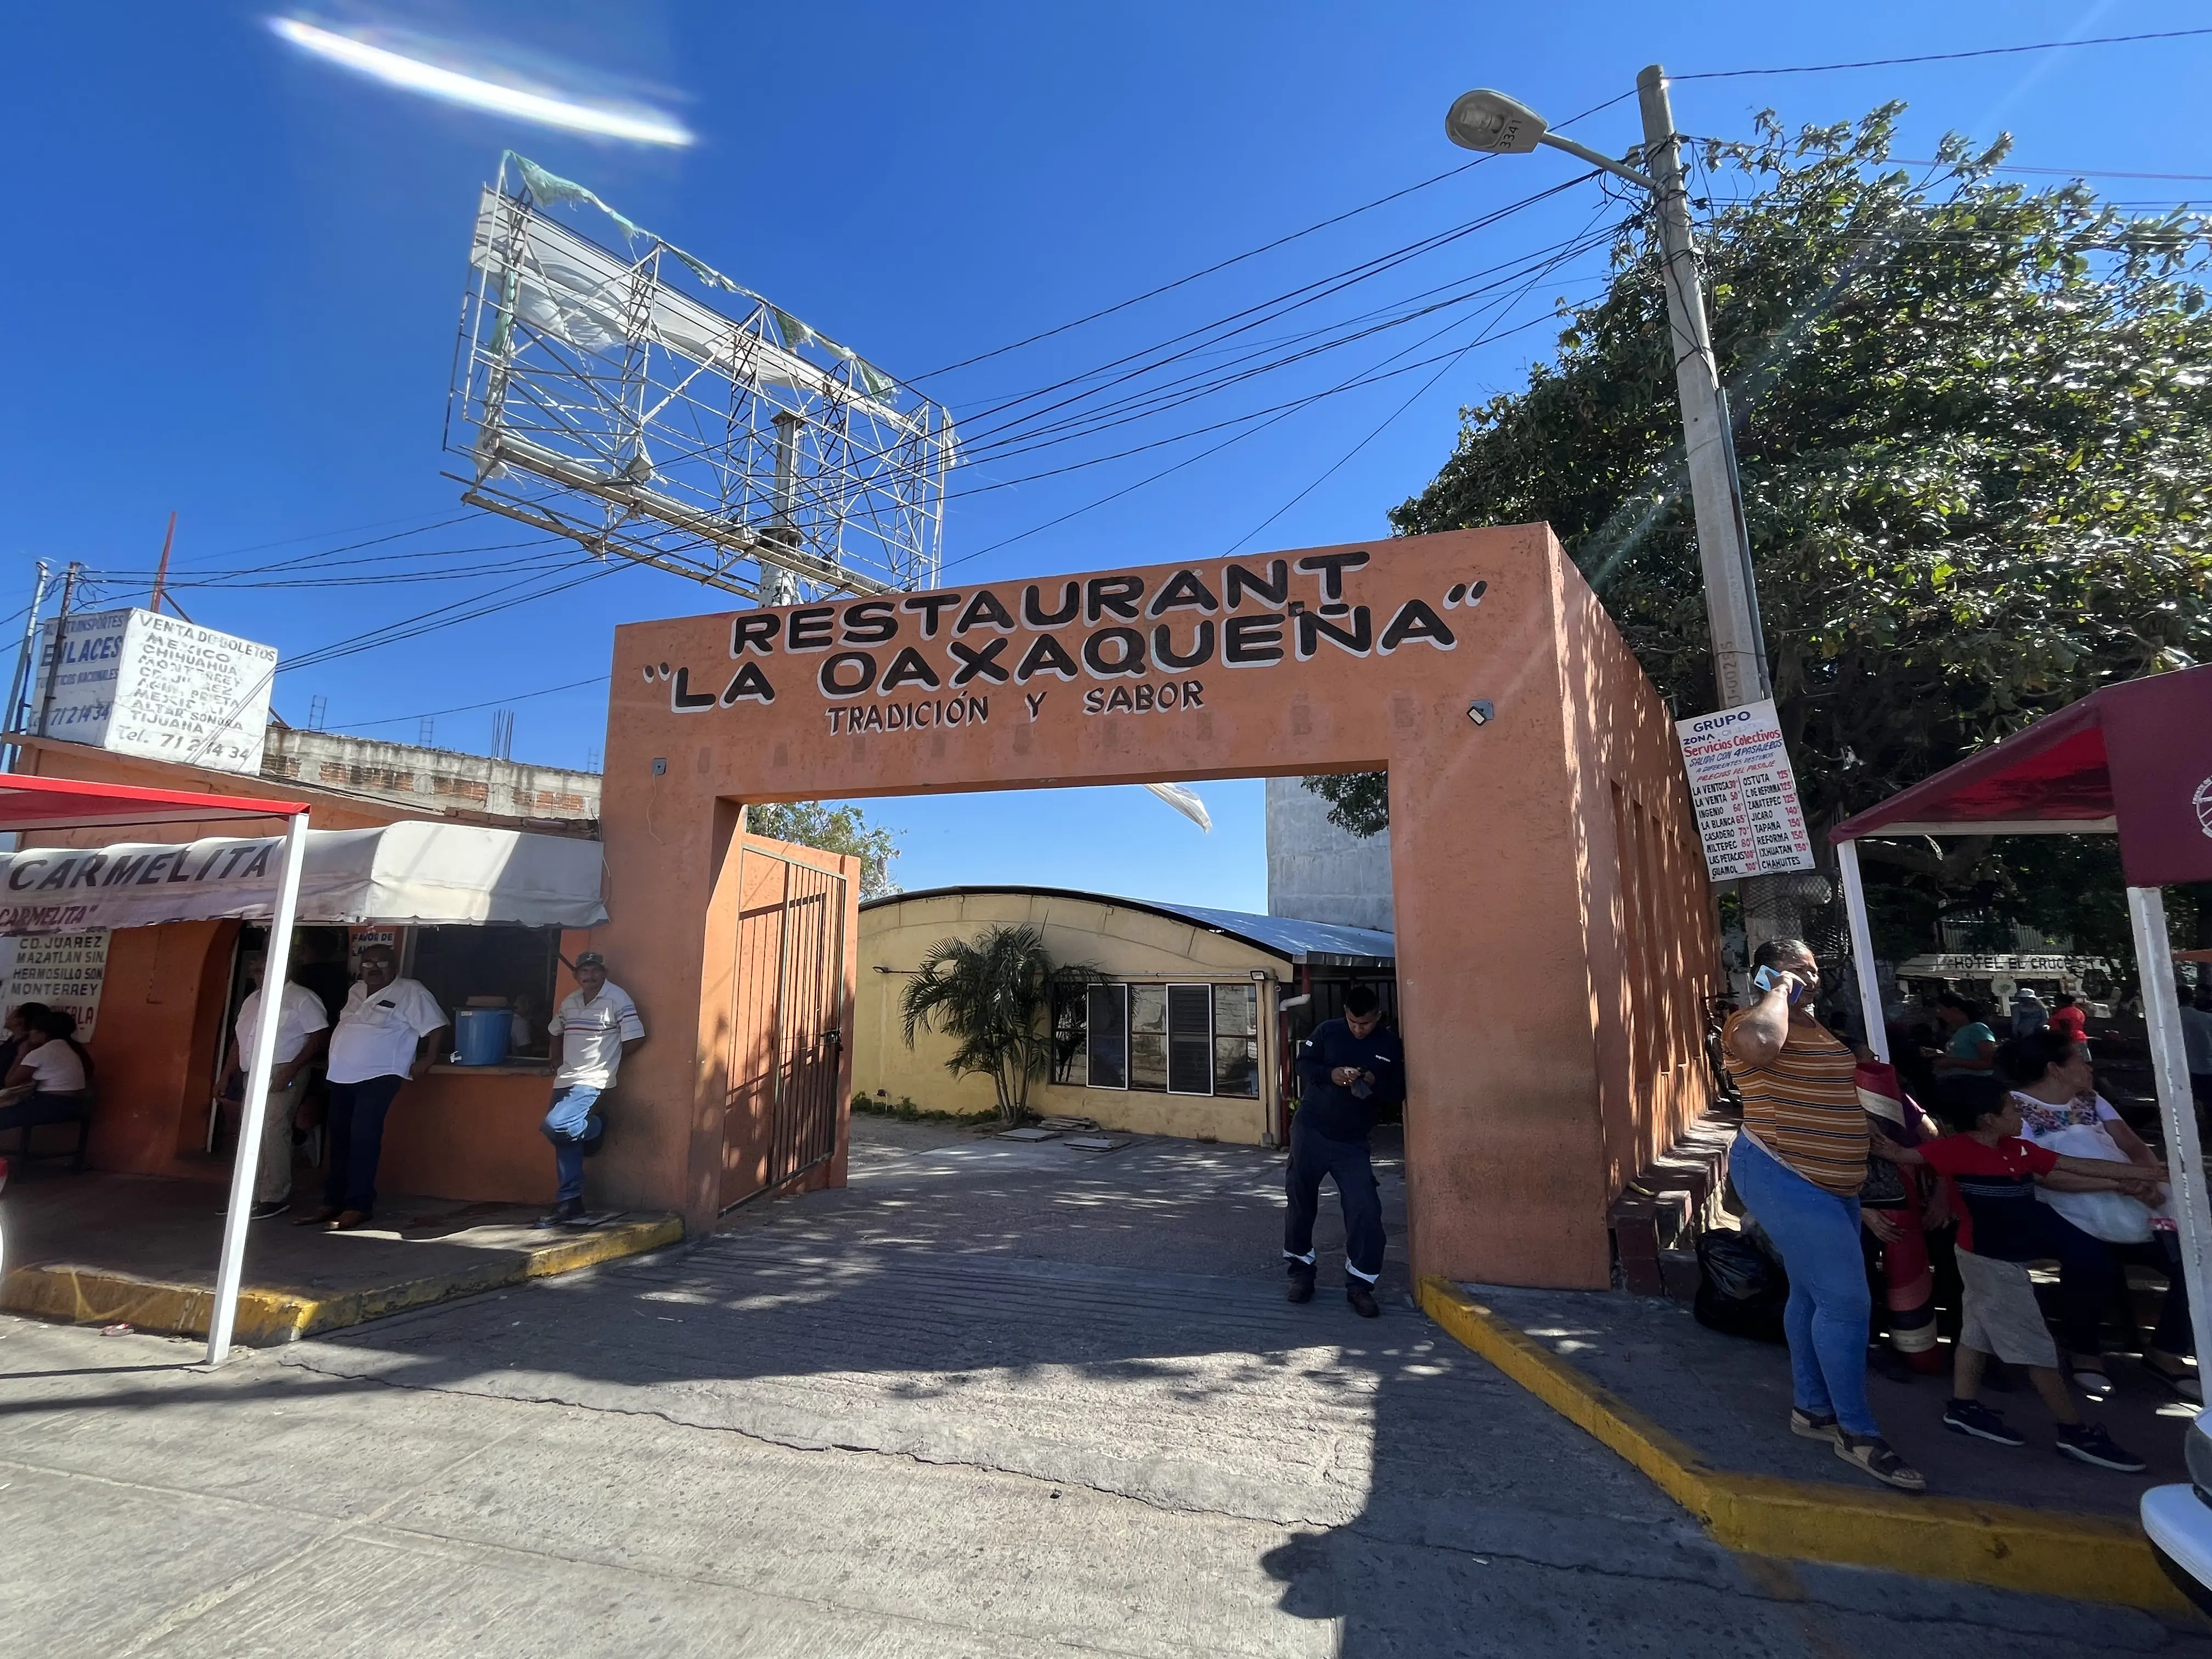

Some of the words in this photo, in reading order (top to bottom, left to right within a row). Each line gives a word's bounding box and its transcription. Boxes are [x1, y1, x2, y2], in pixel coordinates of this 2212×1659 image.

[1499, 119, 1522, 148] 3341
[730, 551, 1370, 659] RESTAURANT
[139, 613, 194, 641] VENTA
[219, 636, 275, 662] BOLETOS
[143, 644, 238, 676] CHIHUAHUA
[134, 688, 223, 715] MEXICLI
[825, 690, 989, 737] TRADICIÓN
[1024, 691, 1048, 723] Y
[1082, 680, 1206, 715] SABOR
[131, 710, 204, 734] TIJUANA
[190, 712, 243, 731] SONORA
[1693, 711, 1751, 732] GRUPO
[1683, 733, 1715, 745] ZONA
[1684, 738, 1733, 757] Servicios
[1733, 729, 1781, 747] Colectivos
[160, 733, 184, 751] 71
[187, 739, 201, 752] 2
[206, 742, 224, 757] 14
[228, 746, 250, 761] 34
[1689, 754, 1716, 767] SALIDA
[1717, 750, 1732, 761] CON
[1734, 748, 1741, 757] 4
[1702, 759, 1742, 772] DIFERENTES
[1744, 752, 1774, 763] DESTINOS
[1696, 769, 1731, 782] PRECIOS
[1733, 767, 1745, 775] DEL
[1746, 760, 1775, 772] PASAJE
[1743, 773, 1770, 786] OSTUTA
[1692, 786, 1702, 796] LA
[1702, 781, 1729, 795] VENTOSA
[1758, 784, 1781, 795] REFORMA
[1695, 798, 1705, 808] LA
[1704, 793, 1728, 806] VENTA
[1747, 796, 1782, 810] ZANATEPEC
[1699, 806, 1724, 819] INGENIO
[1751, 810, 1773, 821] JICARO
[1701, 821, 1710, 831] LA
[1711, 816, 1736, 828] BLANCA
[1754, 820, 1781, 833] TAPANA
[1705, 829, 1735, 842] CASADERO
[1757, 832, 1789, 845] REFORMA
[1707, 840, 1737, 853] MILTEPEC
[1759, 844, 1793, 857] IXHUATAN
[1708, 854, 1720, 865] LAS
[1720, 850, 1745, 863] PETACAS
[1762, 856, 1801, 869] CHAHUITES
[9, 845, 273, 891] CARMELITA
[1712, 865, 1738, 877] GUAMOL
[44, 936, 103, 949] JUAREZ
[381, 933, 393, 941] DE
[16, 951, 82, 964] MAZATLAN
[1955, 957, 2004, 969] HOTEL
[2009, 957, 2025, 969] EL
[13, 968, 82, 980] HERMOSILLO
[10, 983, 99, 996] MONTERREY
